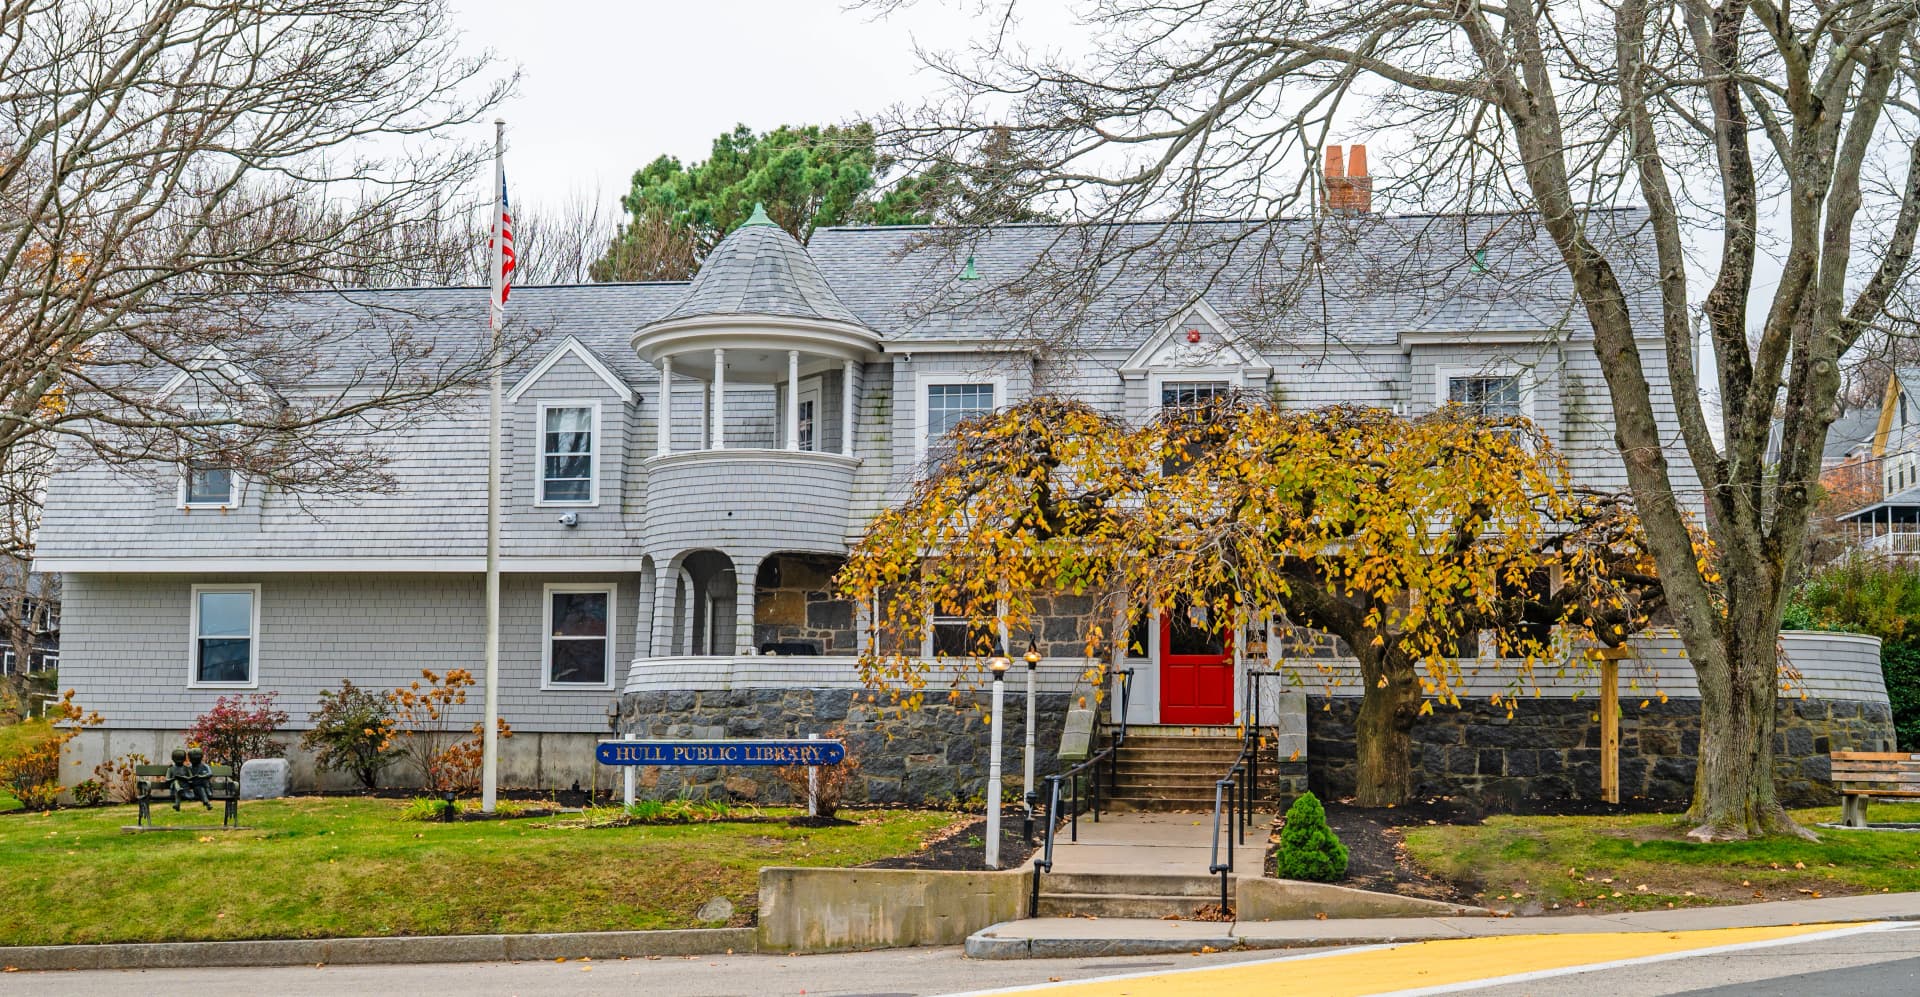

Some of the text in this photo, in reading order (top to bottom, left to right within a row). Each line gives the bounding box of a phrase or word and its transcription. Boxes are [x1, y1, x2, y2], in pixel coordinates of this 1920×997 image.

[615, 746, 824, 761] HULL PUBLIC LIBRARY
